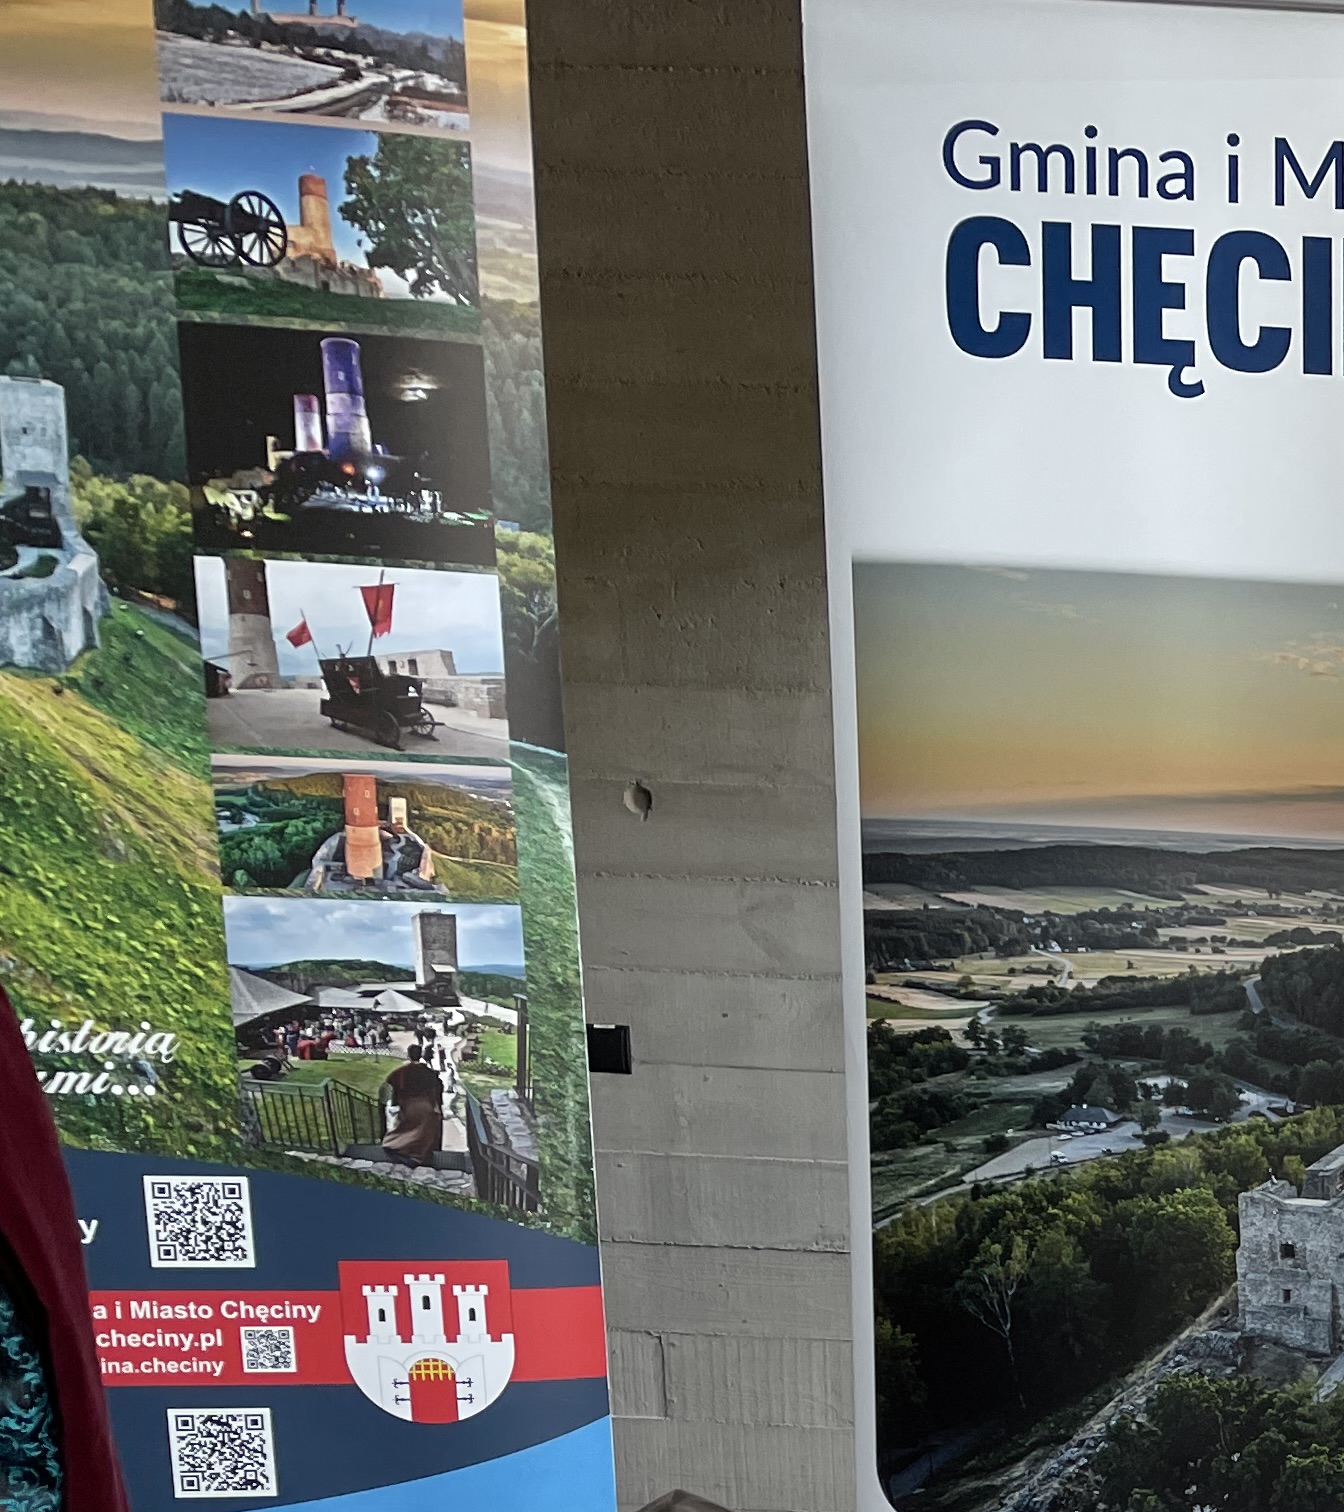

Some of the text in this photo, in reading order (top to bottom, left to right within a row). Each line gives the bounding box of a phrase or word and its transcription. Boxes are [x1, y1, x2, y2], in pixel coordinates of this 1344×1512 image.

[942, 120, 1196, 202] Gmina
[1226, 132, 1240, 204] i
[36, 1061, 156, 1096] mi...
[115, 1301, 121, 1319] i
[130, 1301, 213, 1320] Miasto
[220, 1300, 321, 1322] Chęciny
[96, 1329, 222, 1352] checiny.pl
[101, 1357, 224, 1376] ina.checiny
